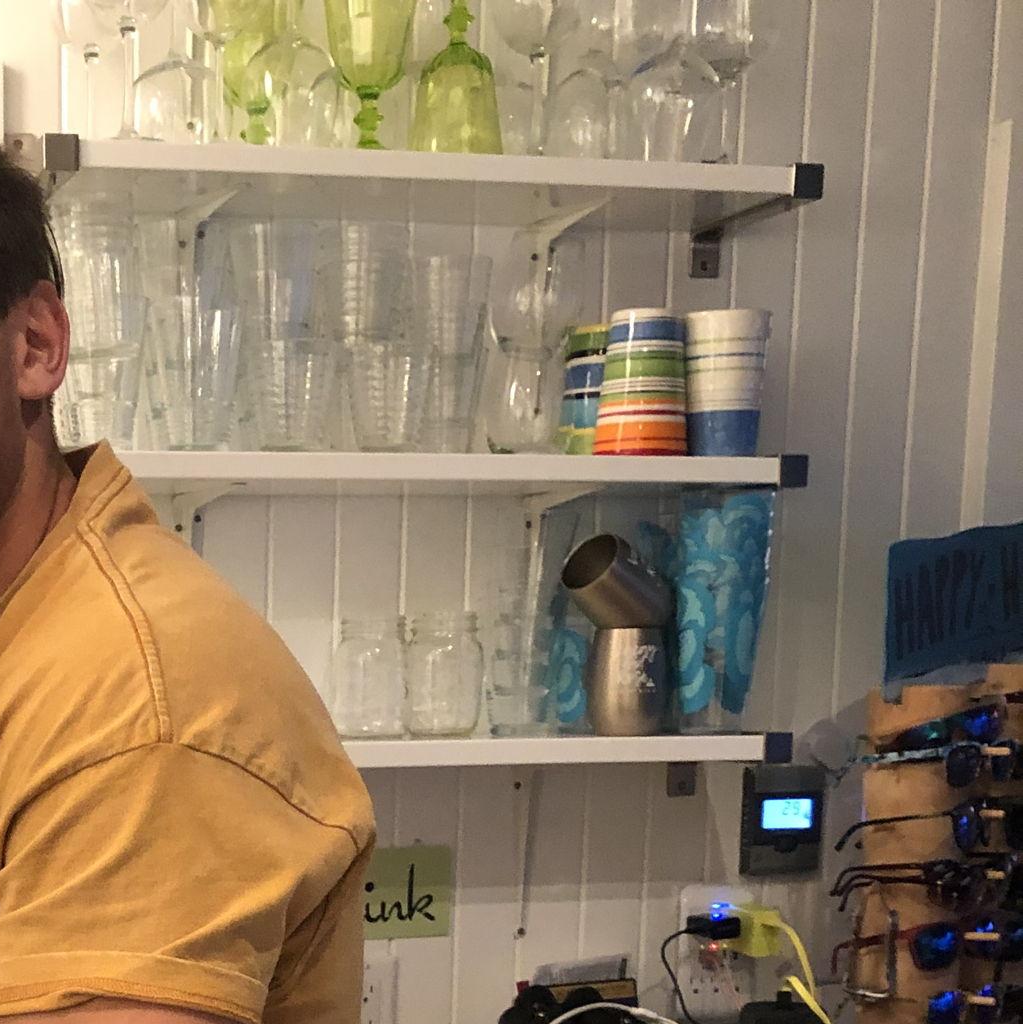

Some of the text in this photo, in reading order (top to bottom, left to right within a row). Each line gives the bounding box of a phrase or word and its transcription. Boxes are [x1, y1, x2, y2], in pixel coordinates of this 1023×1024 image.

[894, 540, 1023, 661] HAPPY H
[363, 862, 436, 924] ink
